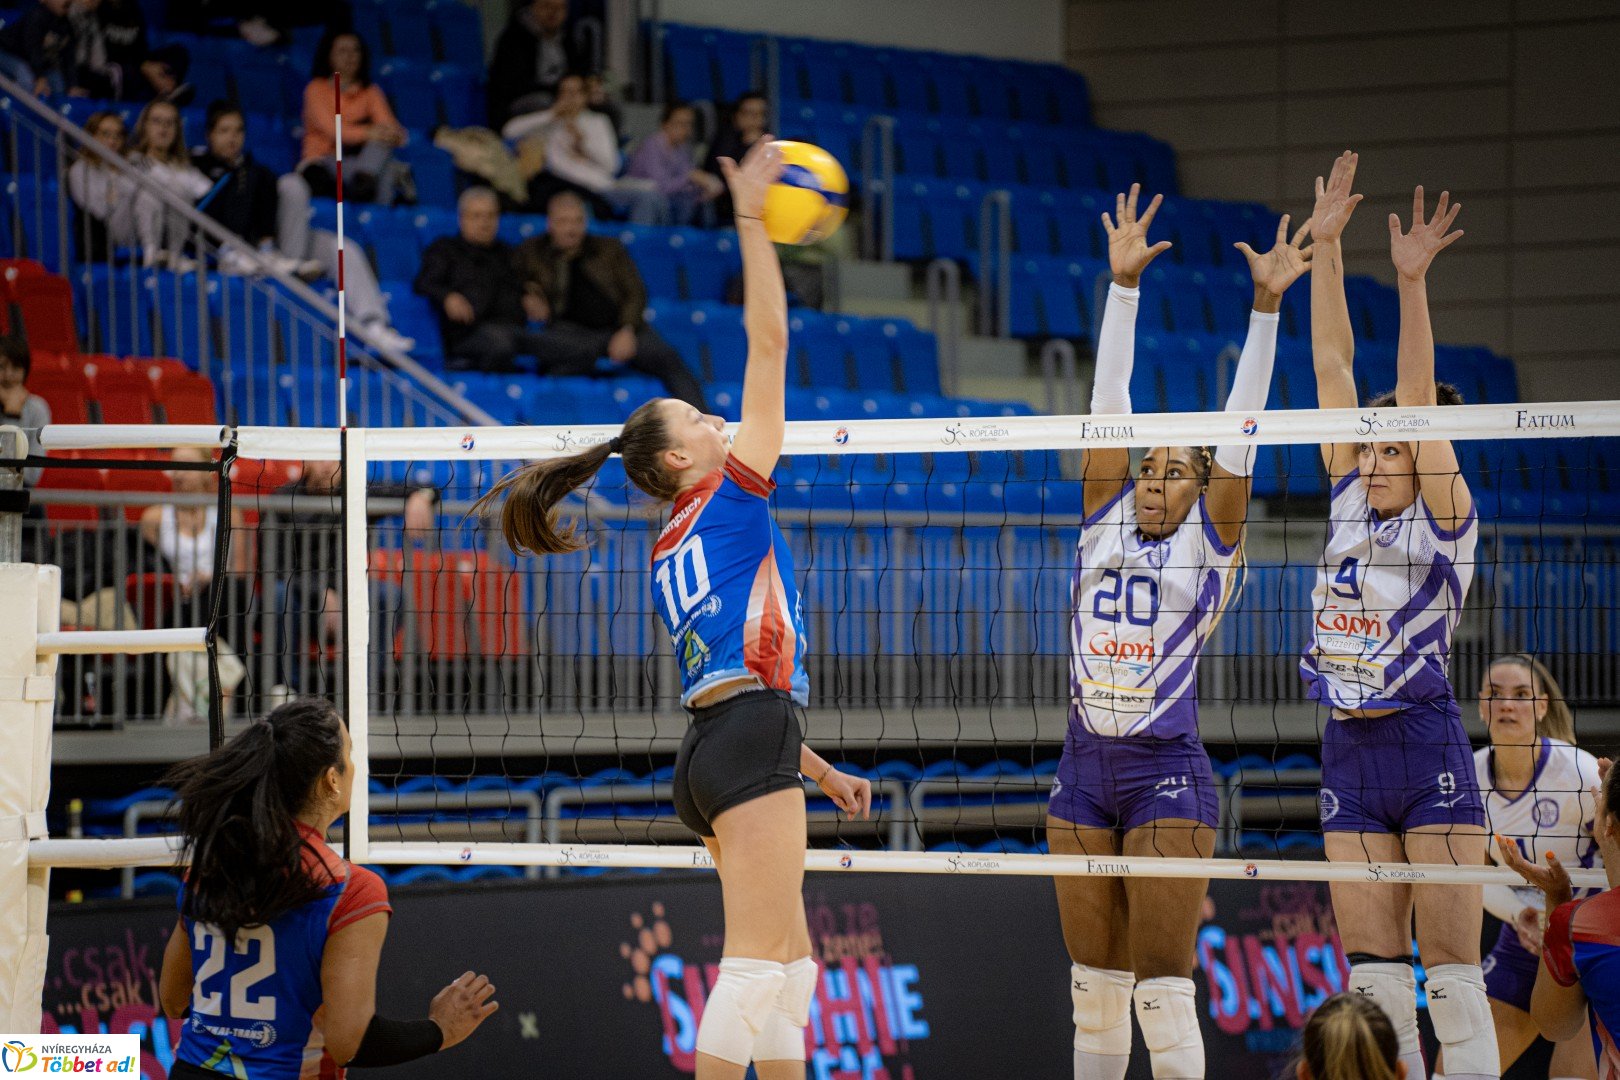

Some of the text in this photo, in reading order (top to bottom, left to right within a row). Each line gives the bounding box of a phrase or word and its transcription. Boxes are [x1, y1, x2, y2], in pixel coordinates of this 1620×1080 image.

[1081, 421, 1134, 438] FATUM
[1386, 418, 1430, 427] RÖPLABDA
[1514, 410, 1575, 428] FATUM
[656, 534, 711, 630] 10
[1331, 556, 1362, 600] 9
[1093, 568, 1159, 627] 20
[1316, 605, 1381, 637] Capri
[1088, 632, 1154, 664] Capri
[1326, 636, 1360, 651] Pizzeria
[1438, 771, 1456, 795] 9
[1086, 859, 1130, 874] FATUM
[192, 921, 276, 1020] 22
